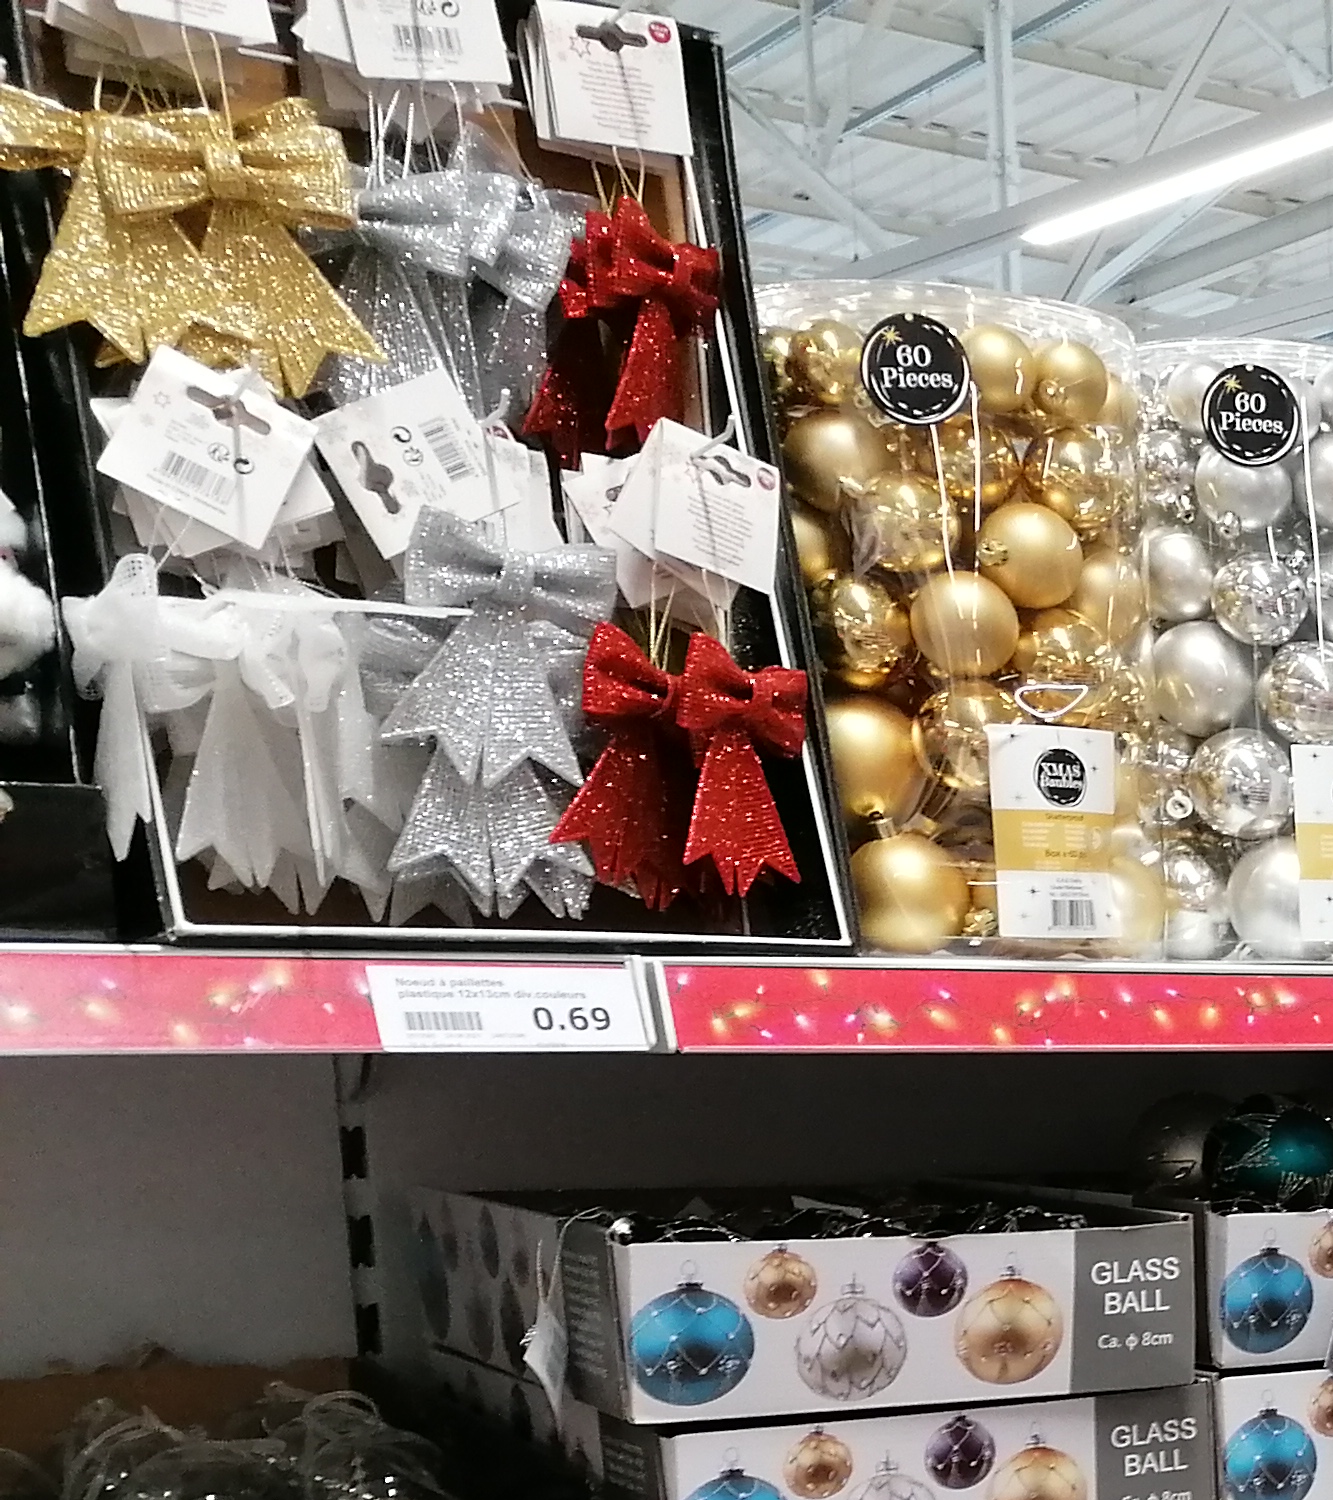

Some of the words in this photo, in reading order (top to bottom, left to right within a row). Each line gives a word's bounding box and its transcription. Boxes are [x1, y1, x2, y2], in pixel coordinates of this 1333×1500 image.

[896, 344, 932, 367] 60
[880, 366, 954, 390] Pieces
[1235, 393, 1267, 414] 60
[1220, 412, 1285, 435] Pieces
[1040, 763, 1081, 776] XMAS
[399, 989, 454, 1000] plastique
[532, 1007, 610, 1031] 0.69
[1091, 1257, 1180, 1285] GLASS
[1104, 1289, 1170, 1315] BALL
[1098, 1334, 1121, 1349] Ca.
[1141, 1332, 1173, 1347] 8cm
[1111, 1417, 1198, 1447] GLASS
[1124, 1449, 1188, 1477] BALL
